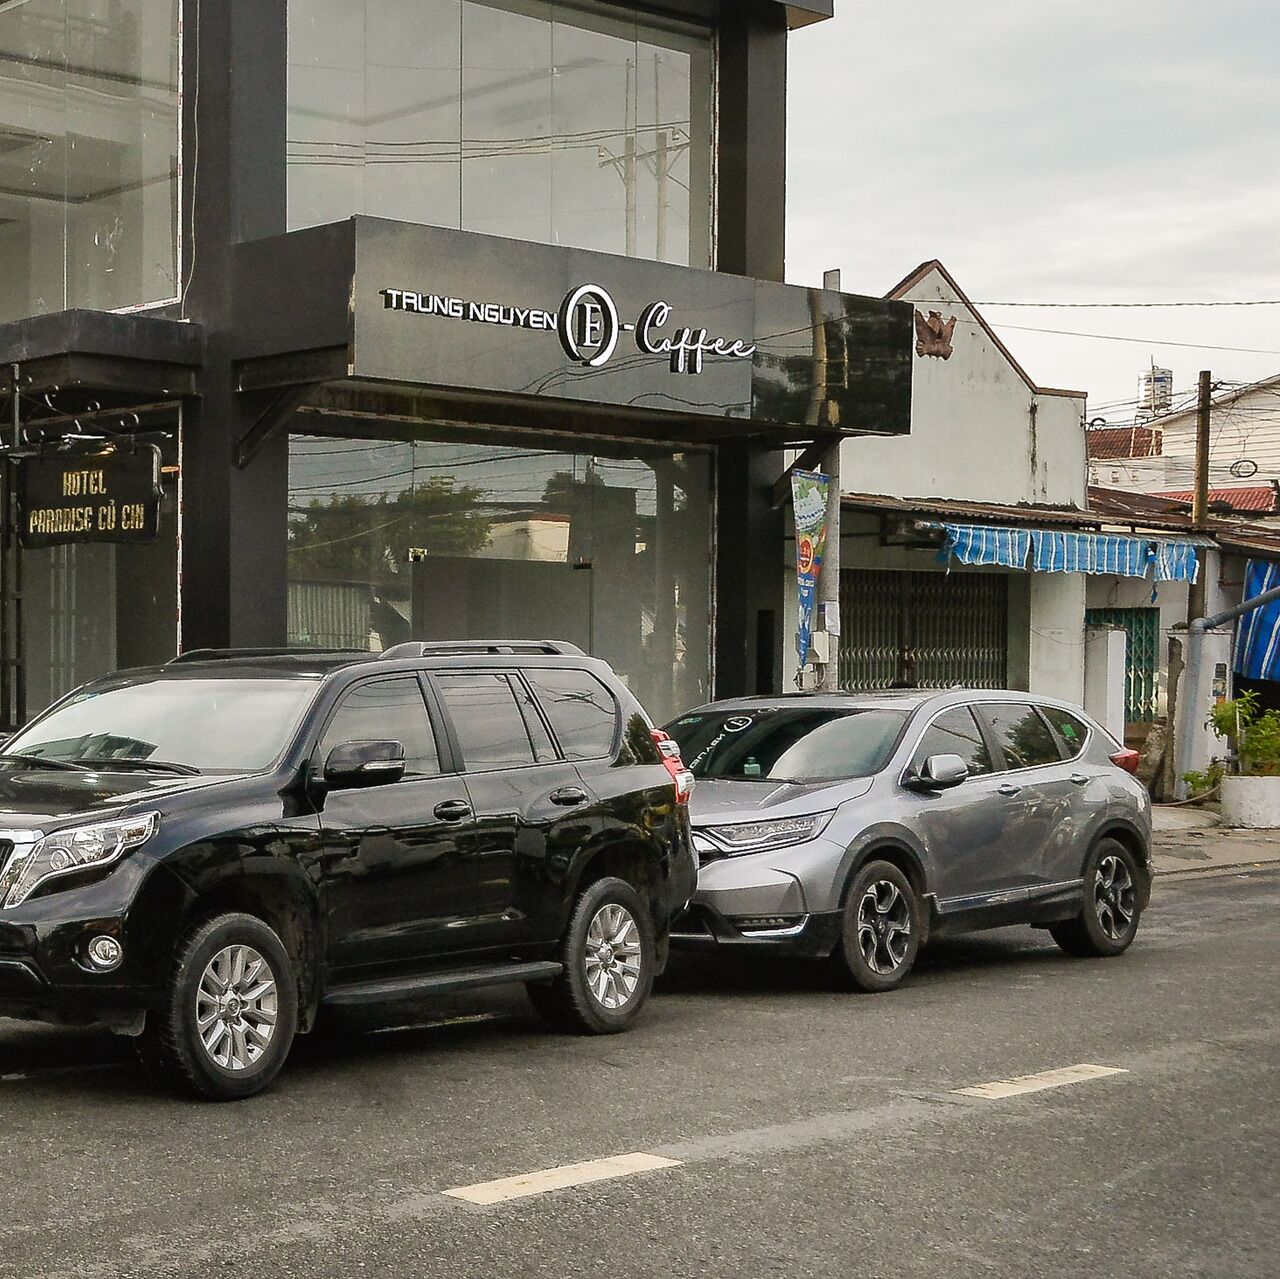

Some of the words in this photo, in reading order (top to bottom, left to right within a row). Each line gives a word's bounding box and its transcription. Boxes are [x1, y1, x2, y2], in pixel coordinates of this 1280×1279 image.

[385, 288, 464, 317] TRUNG
[469, 300, 558, 331] NGUYEN
[62, 470, 107, 497] HOTEL
[29, 506, 93, 534] PARADISE
